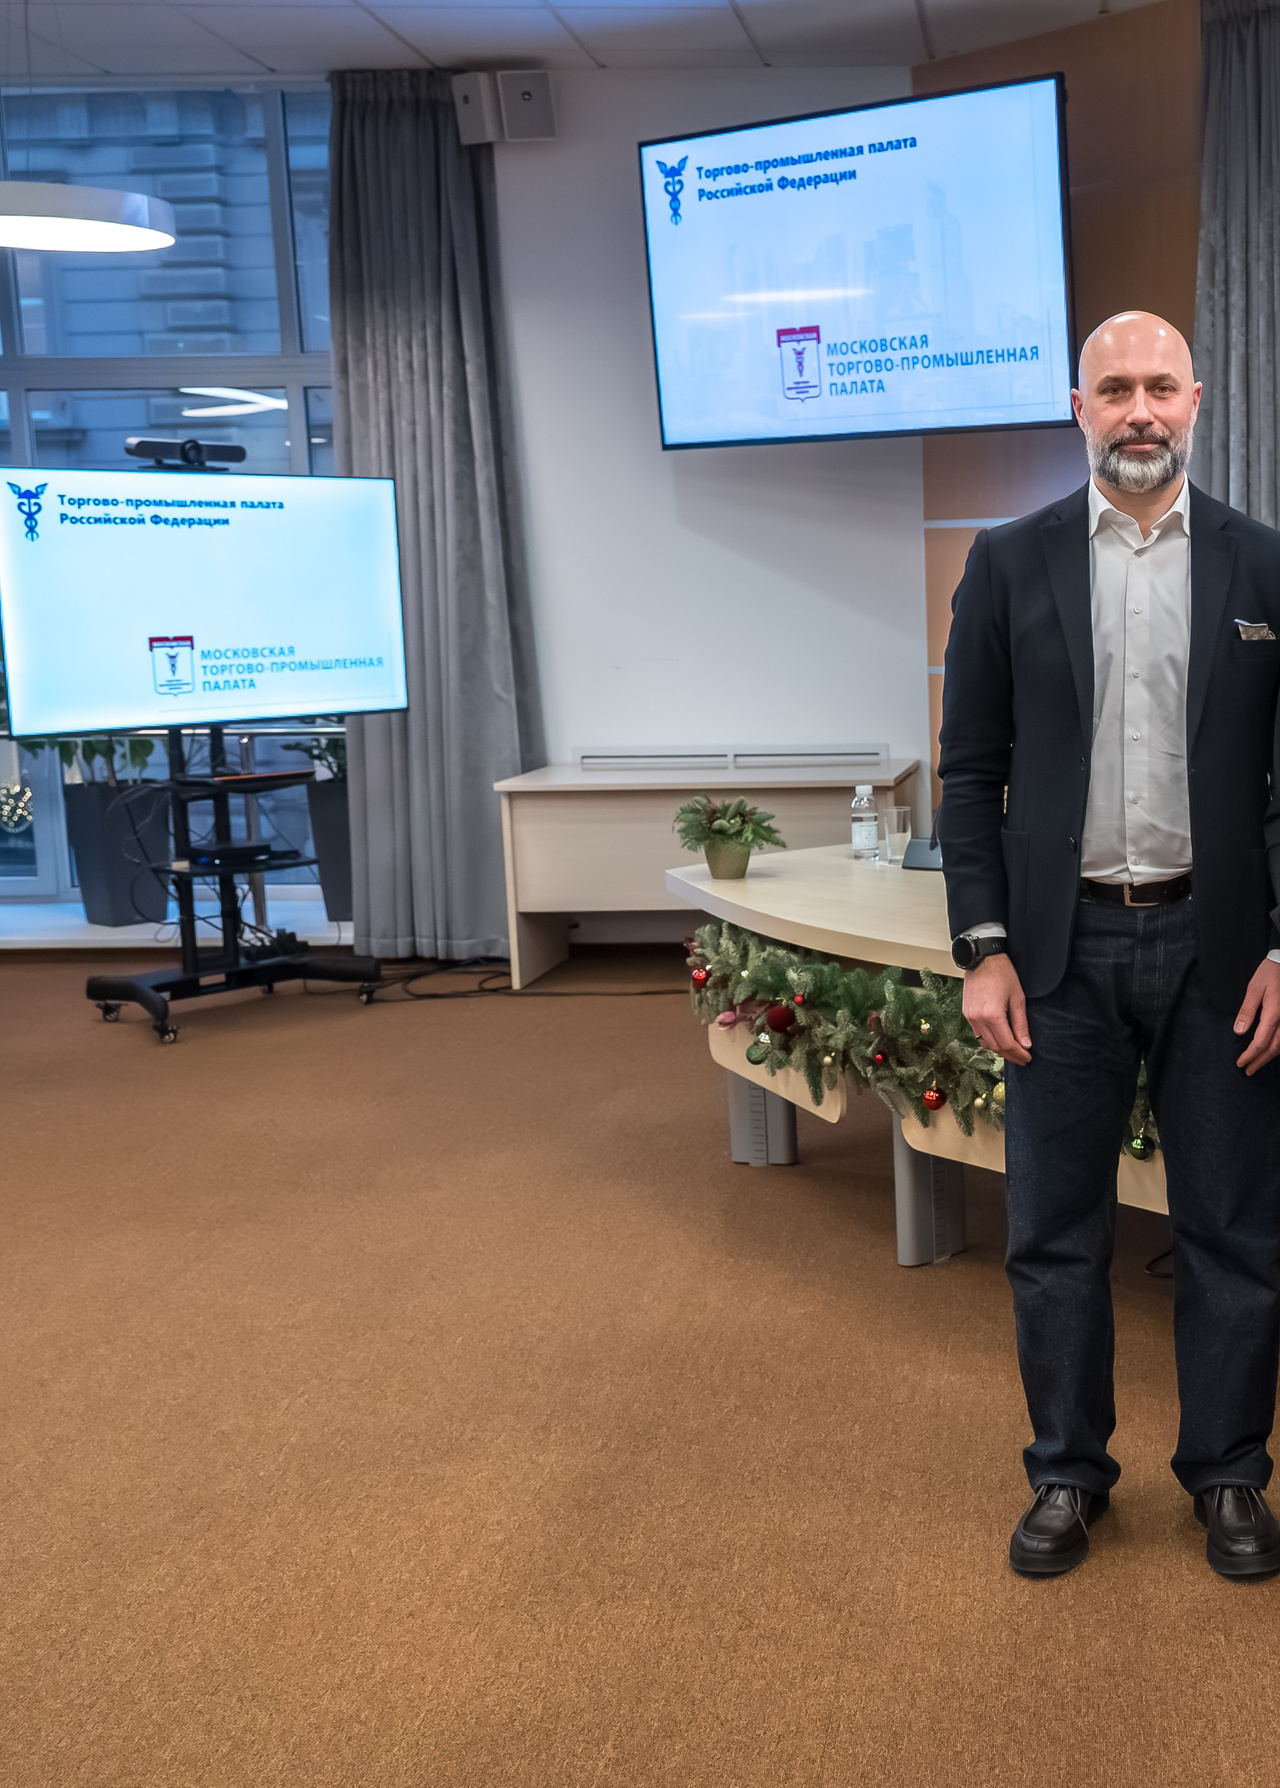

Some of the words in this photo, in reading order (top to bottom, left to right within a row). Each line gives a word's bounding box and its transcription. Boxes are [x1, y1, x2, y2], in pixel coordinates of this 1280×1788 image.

[697, 143, 864, 181] Торгово-промышленная
[869, 136, 917, 154] палата
[698, 178, 774, 202] Российской
[777, 168, 857, 191] Федерации
[827, 334, 929, 357] МОСКОВСКАЯ
[828, 345, 1040, 377] ТОРГОВО-ПРОМЫШЛЕННАЯ
[829, 379, 885, 397] ПАЛАТА
[58, 494, 237, 510] Торгово-промышленная
[241, 500, 285, 510] палата
[60, 513, 146, 526] Российской
[150, 514, 230, 529] Федерации
[201, 646, 296, 661] МОСКОВСКАЯ
[201, 656, 384, 676] ТОРГОВО-ПРОМЫШЛЕННАЯ
[202, 679, 256, 692] ПАЛАТА
